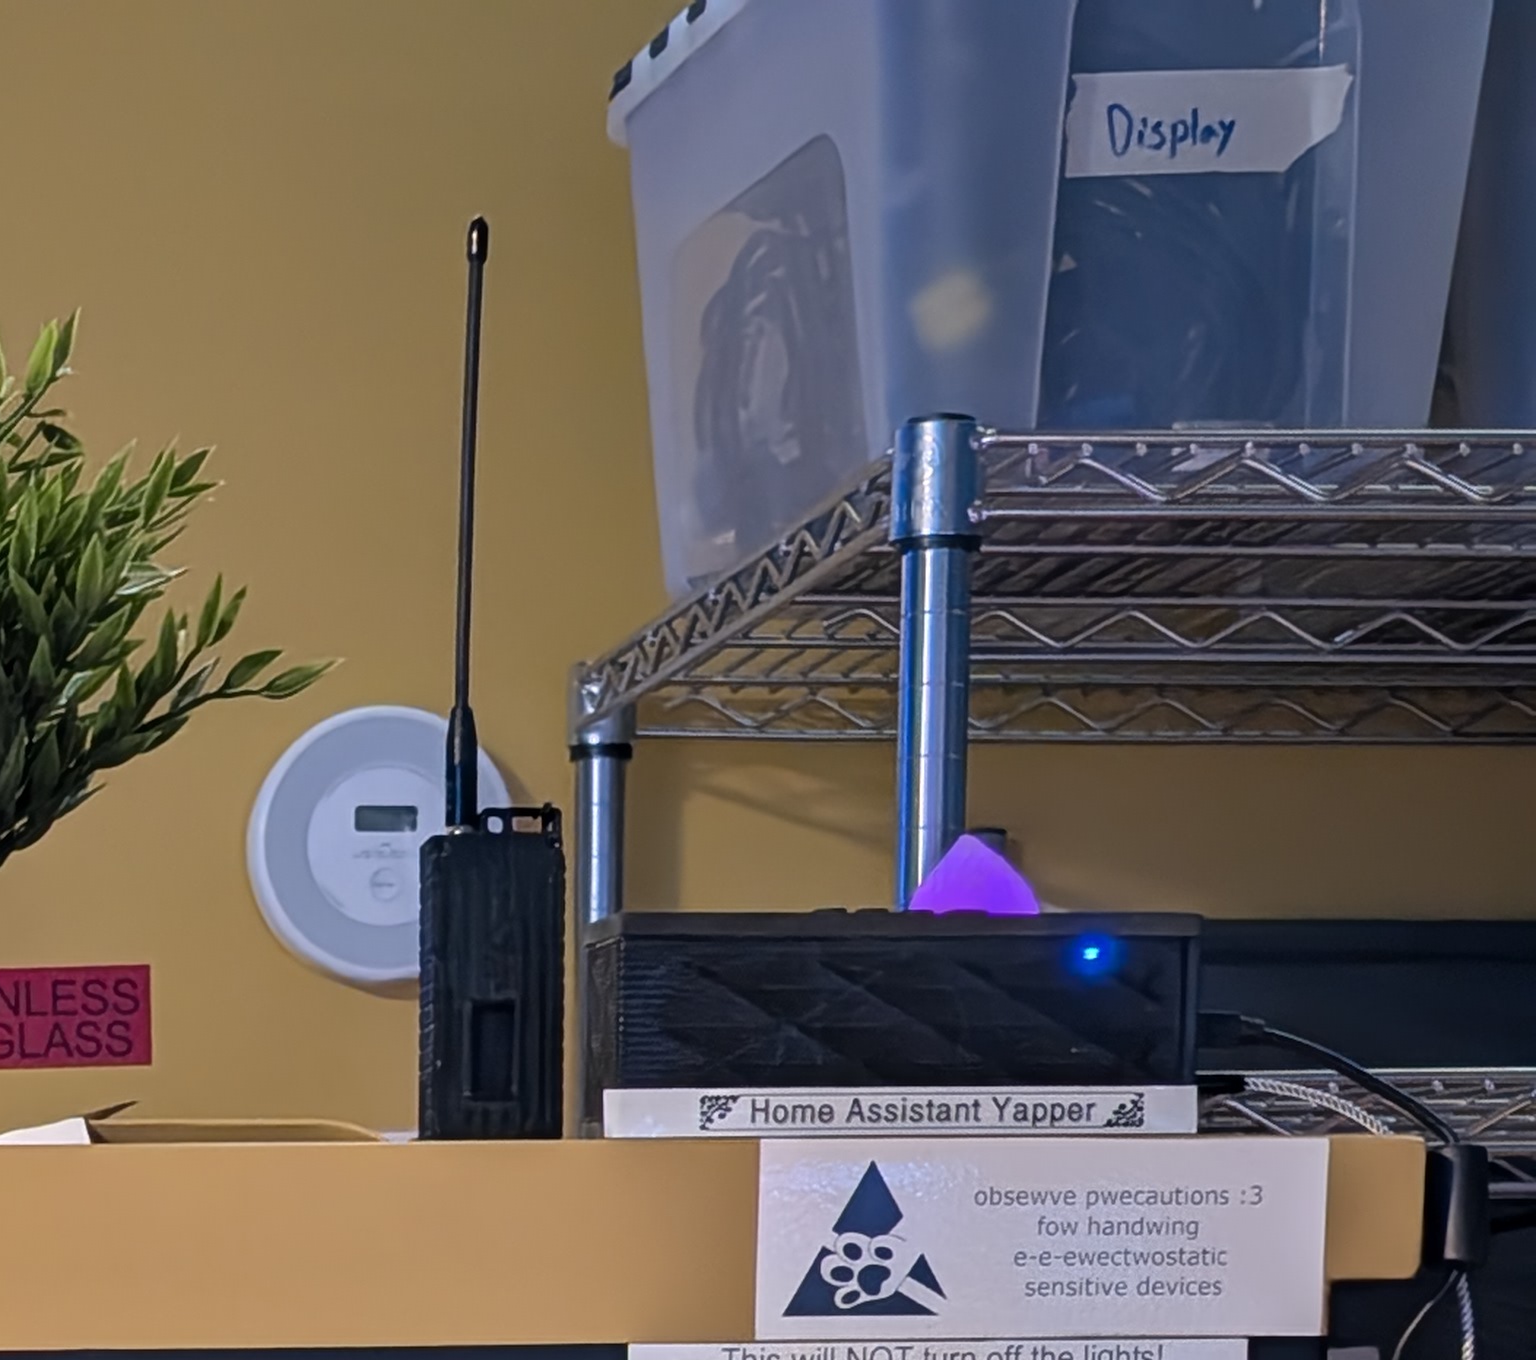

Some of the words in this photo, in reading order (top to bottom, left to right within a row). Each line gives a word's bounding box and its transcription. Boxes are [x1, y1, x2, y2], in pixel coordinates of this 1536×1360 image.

[1107, 103, 1236, 159] Display
[750, 1097, 835, 1124] Home
[845, 1096, 981, 1124] Assistant
[992, 1096, 1097, 1127] Yapper
[974, 1186, 1077, 1206] obsewve
[1086, 1187, 1230, 1210] pwecautions
[1240, 1185, 1263, 1206] :3
[1037, 1215, 1079, 1236] fow
[1087, 1216, 1200, 1240] handwing
[1013, 1246, 1228, 1267] e-e-ewectwostatic
[1024, 1277, 1129, 1297] sensitive
[1136, 1276, 1223, 1297] devices
